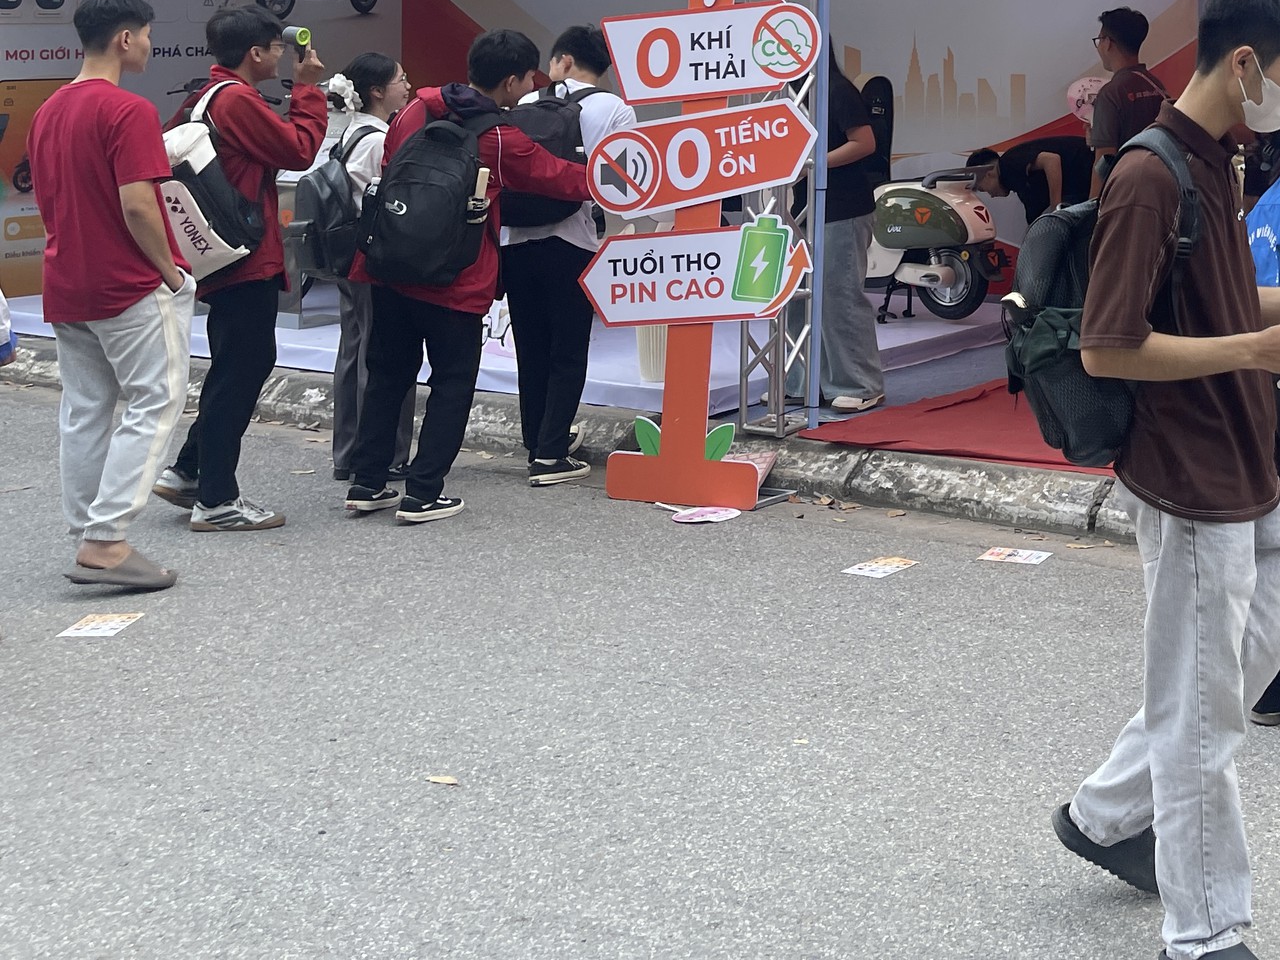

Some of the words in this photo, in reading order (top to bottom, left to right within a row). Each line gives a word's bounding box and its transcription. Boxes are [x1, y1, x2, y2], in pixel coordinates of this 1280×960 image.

[152, 44, 182, 58] PHÁ
[689, 25, 732, 51] KHÍ
[5, 49, 35, 64] MỌI
[39, 46, 71, 61] GIỚI
[636, 27, 682, 89] 0
[689, 53, 746, 81] THẢI
[714, 116, 789, 147] TIẾNG
[666, 127, 711, 190] 0
[718, 150, 757, 178] ỒN
[180, 216, 213, 256] YONEX
[608, 249, 665, 277] TUỔI
[671, 251, 722, 276] THỌ
[610, 281, 657, 305] PIN
[665, 276, 725, 302] CAO
